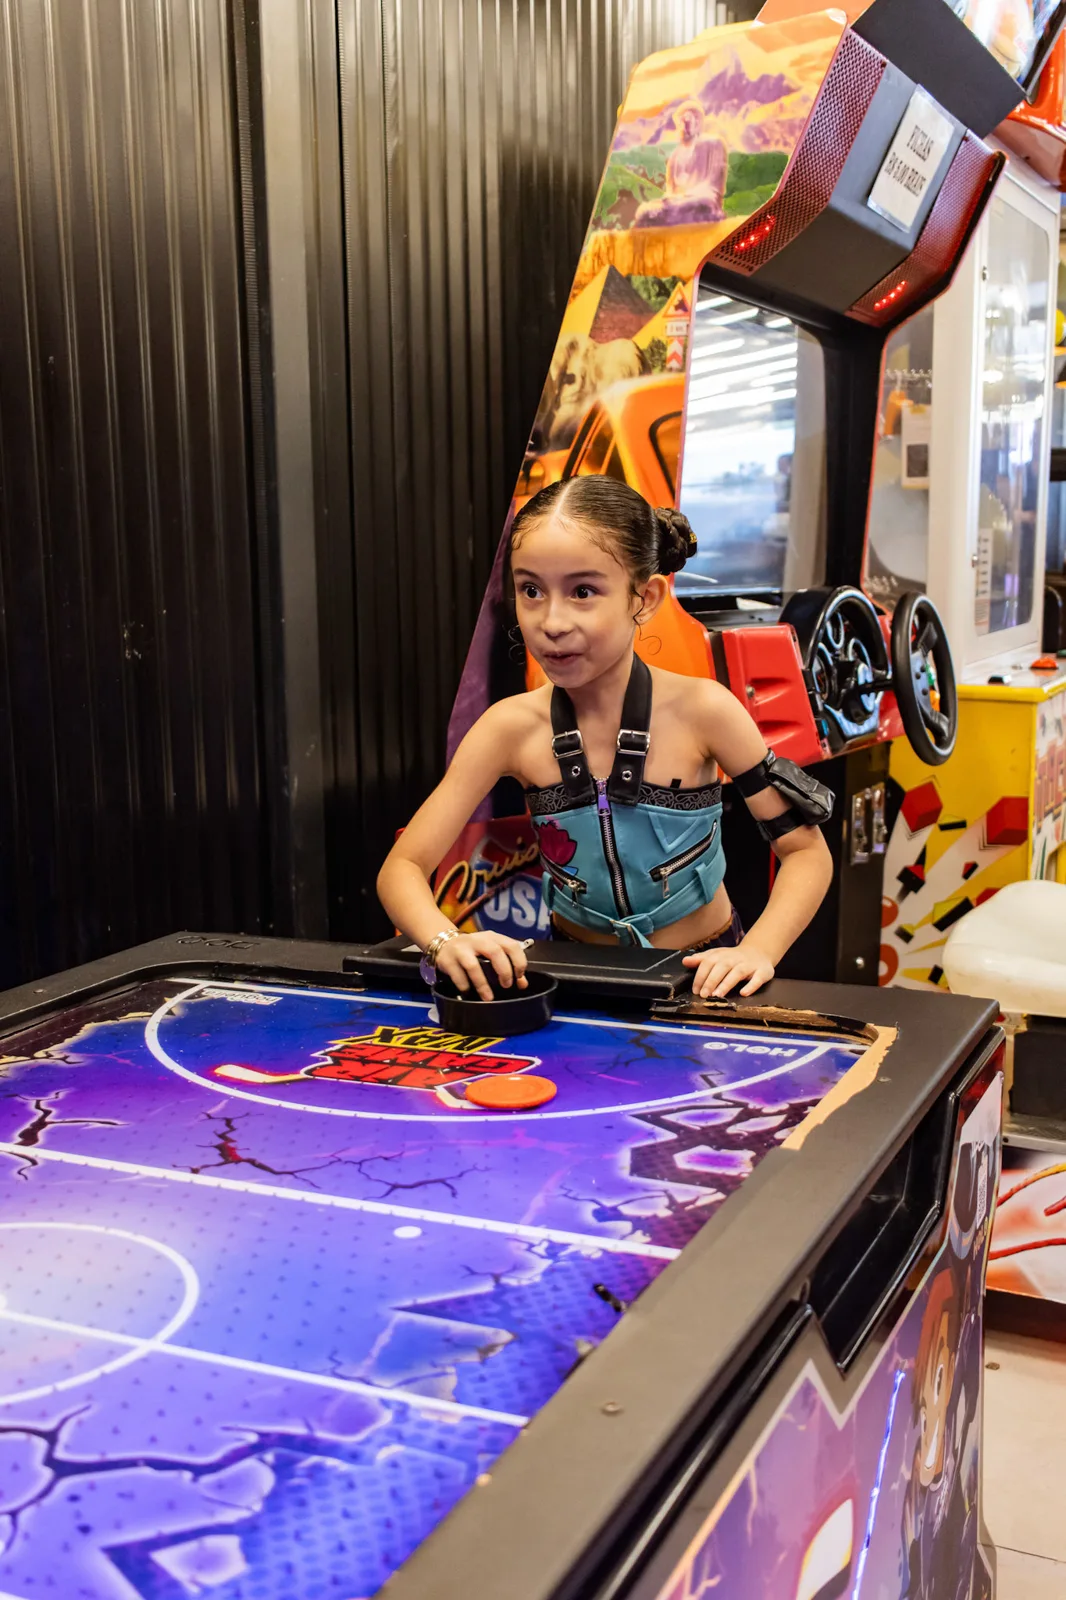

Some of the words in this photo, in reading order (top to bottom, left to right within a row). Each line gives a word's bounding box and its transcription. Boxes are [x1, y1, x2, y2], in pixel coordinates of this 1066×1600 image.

[330, 1026, 504, 1055] MAX
[703, 1041, 798, 1057] HOLO
[325, 1043, 535, 1075] GAME
[311, 1059, 479, 1089] AIR
